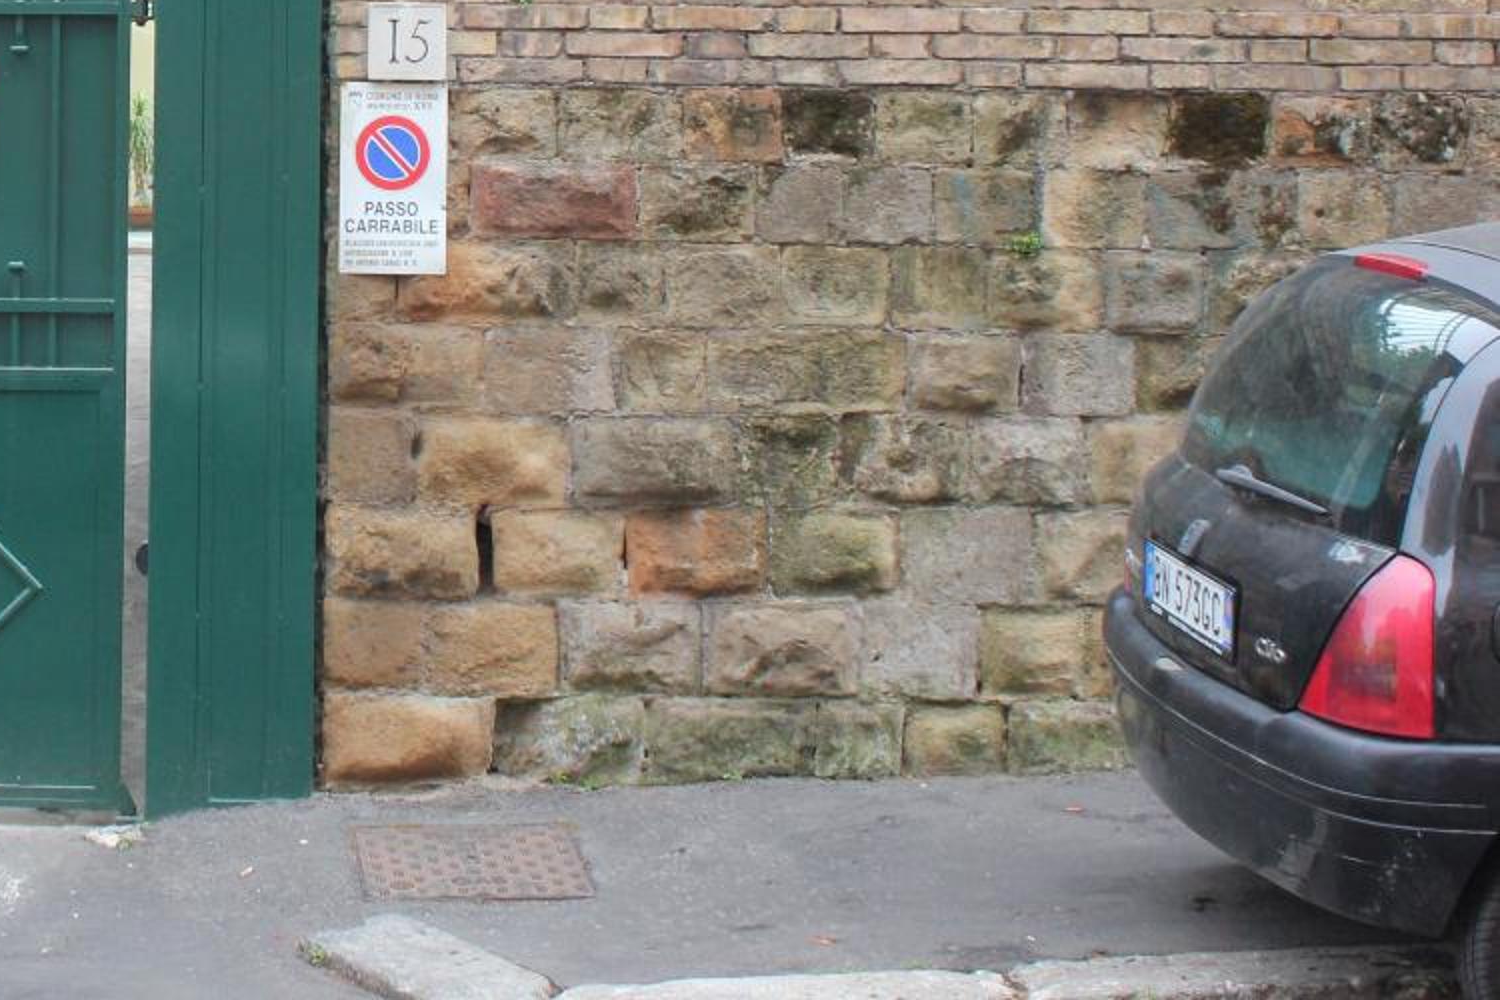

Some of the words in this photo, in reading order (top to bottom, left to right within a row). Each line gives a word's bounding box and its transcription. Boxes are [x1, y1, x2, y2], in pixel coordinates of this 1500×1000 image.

[388, 19, 431, 64] 15
[364, 201, 419, 217] PASSO
[344, 219, 438, 235] CARRABILE
